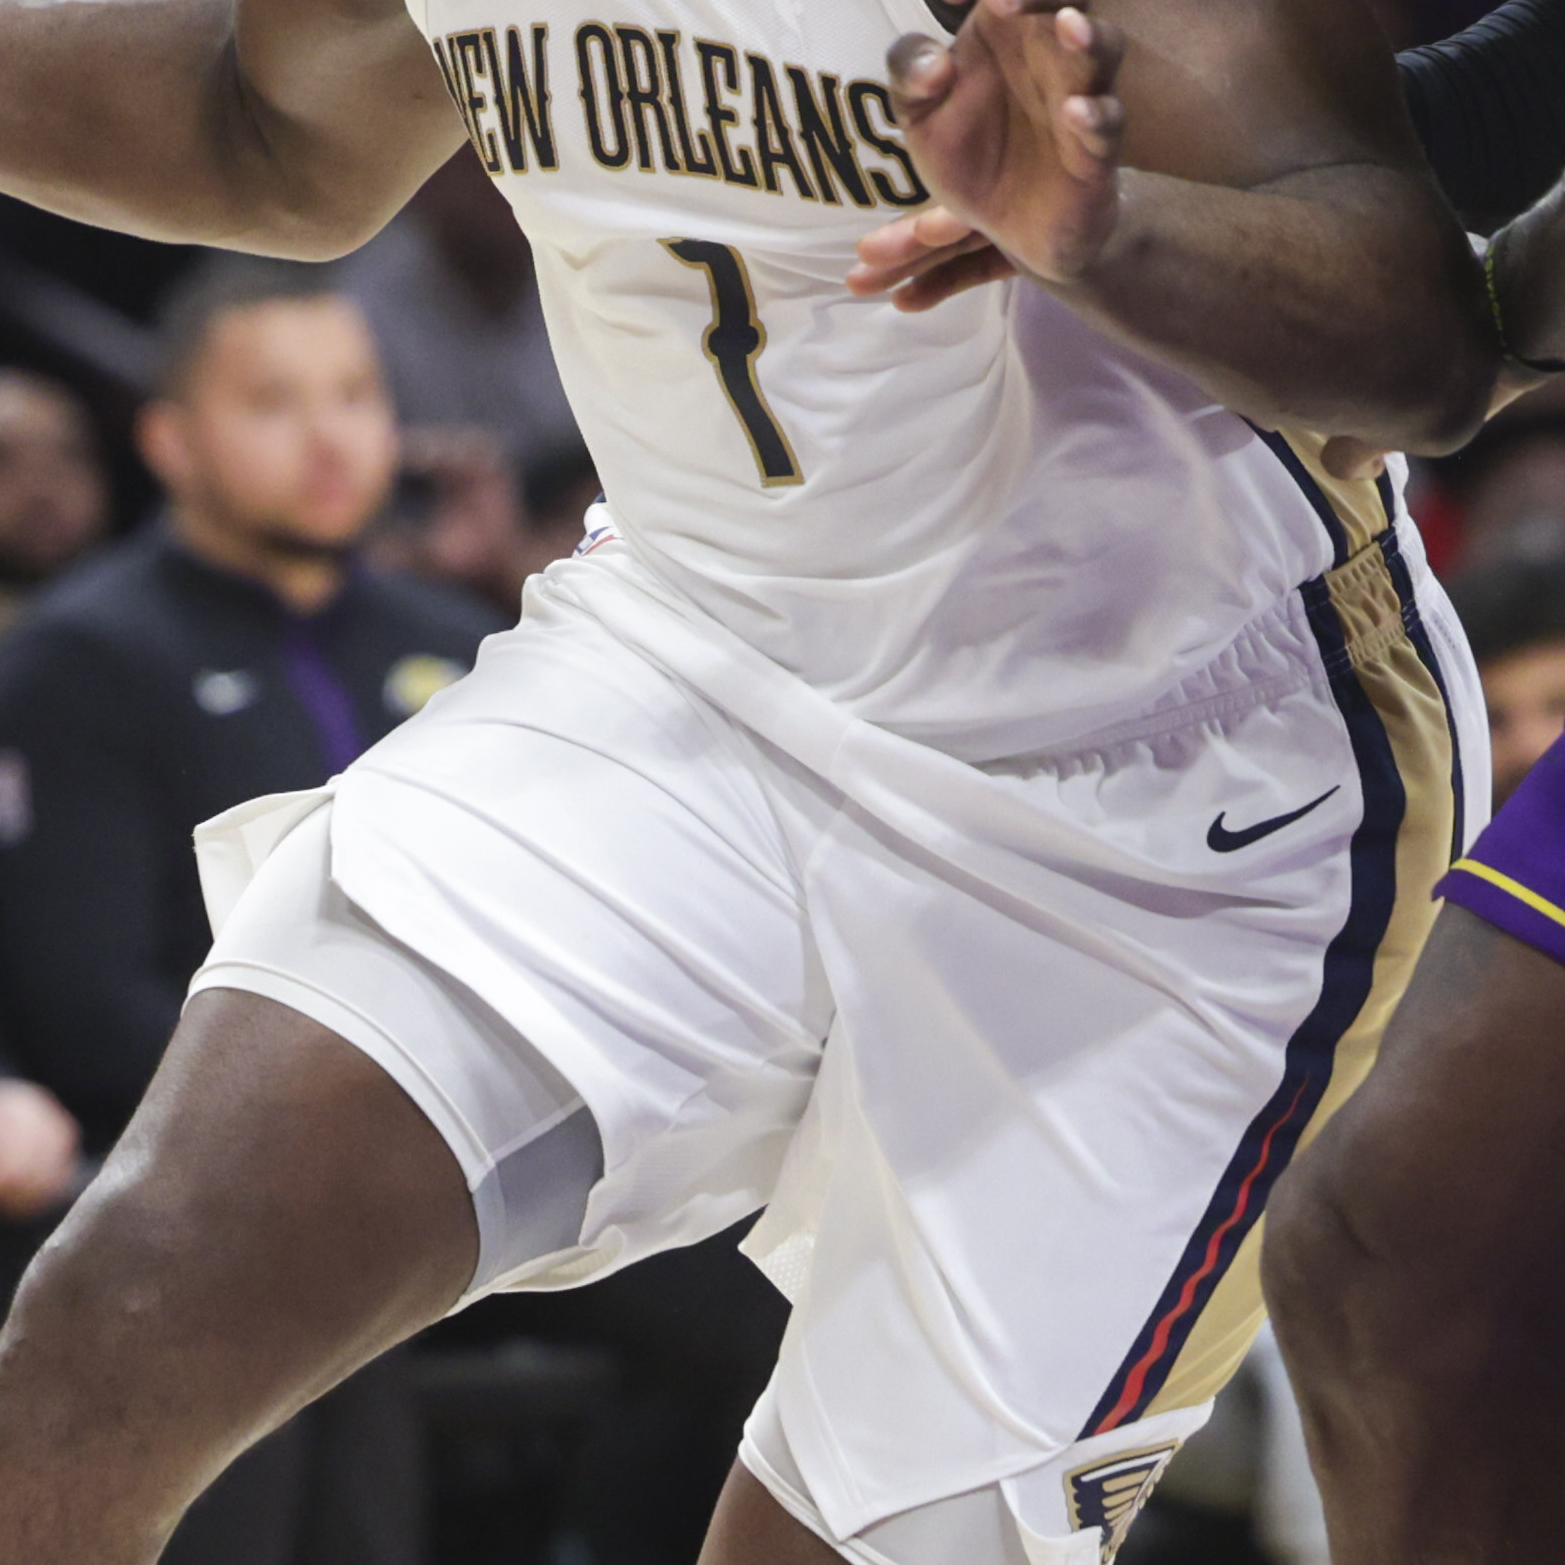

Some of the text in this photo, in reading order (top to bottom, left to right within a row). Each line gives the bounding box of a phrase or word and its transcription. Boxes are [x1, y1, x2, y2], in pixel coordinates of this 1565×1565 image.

[433, 19, 932, 208] NEW ORLEANS
[657, 237, 804, 488] 1
